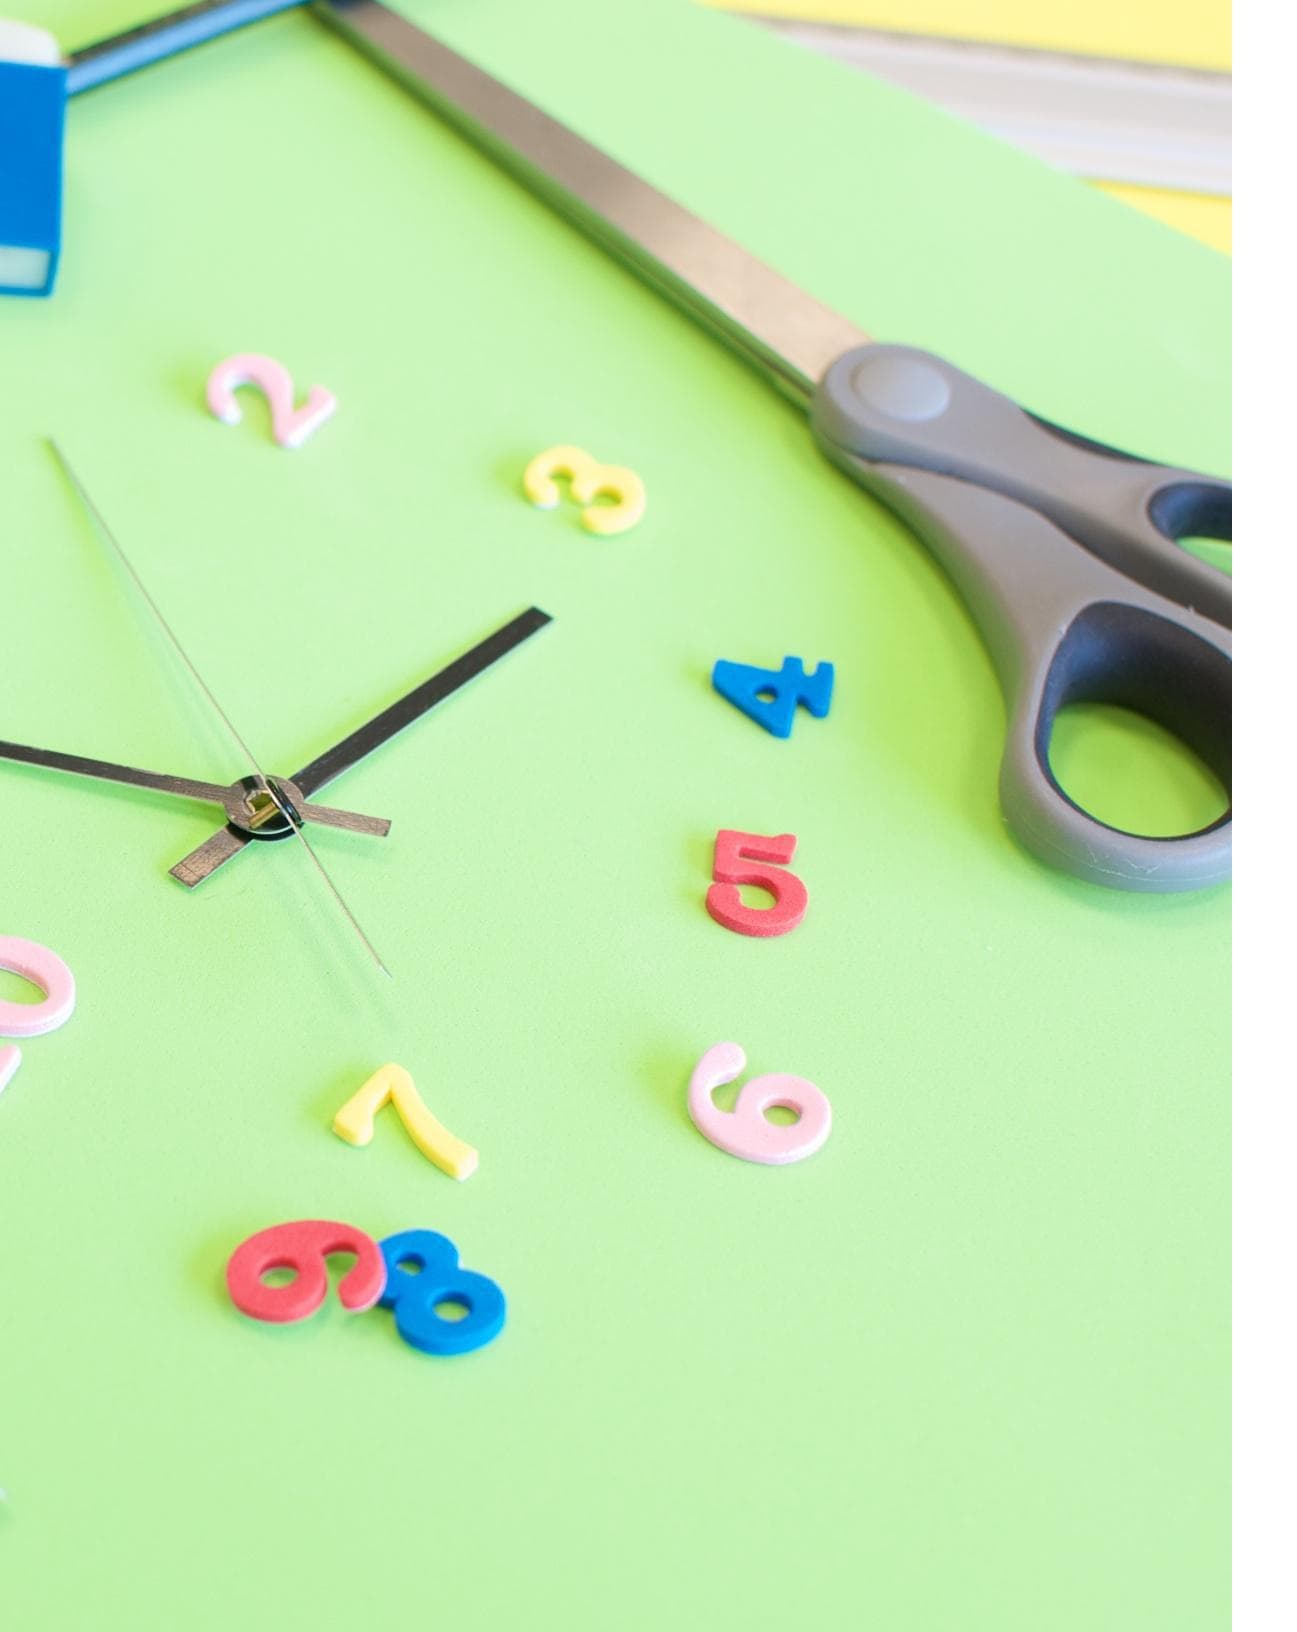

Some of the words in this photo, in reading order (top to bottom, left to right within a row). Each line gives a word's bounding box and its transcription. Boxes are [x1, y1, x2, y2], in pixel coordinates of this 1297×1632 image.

[206, 352, 337, 449] 2
[523, 444, 646, 534] 3
[711, 655, 834, 740] 4
[705, 828, 809, 938] 5
[333, 1063, 479, 1180] 7
[688, 1041, 832, 1165] 6
[376, 1228, 508, 1357] 8
